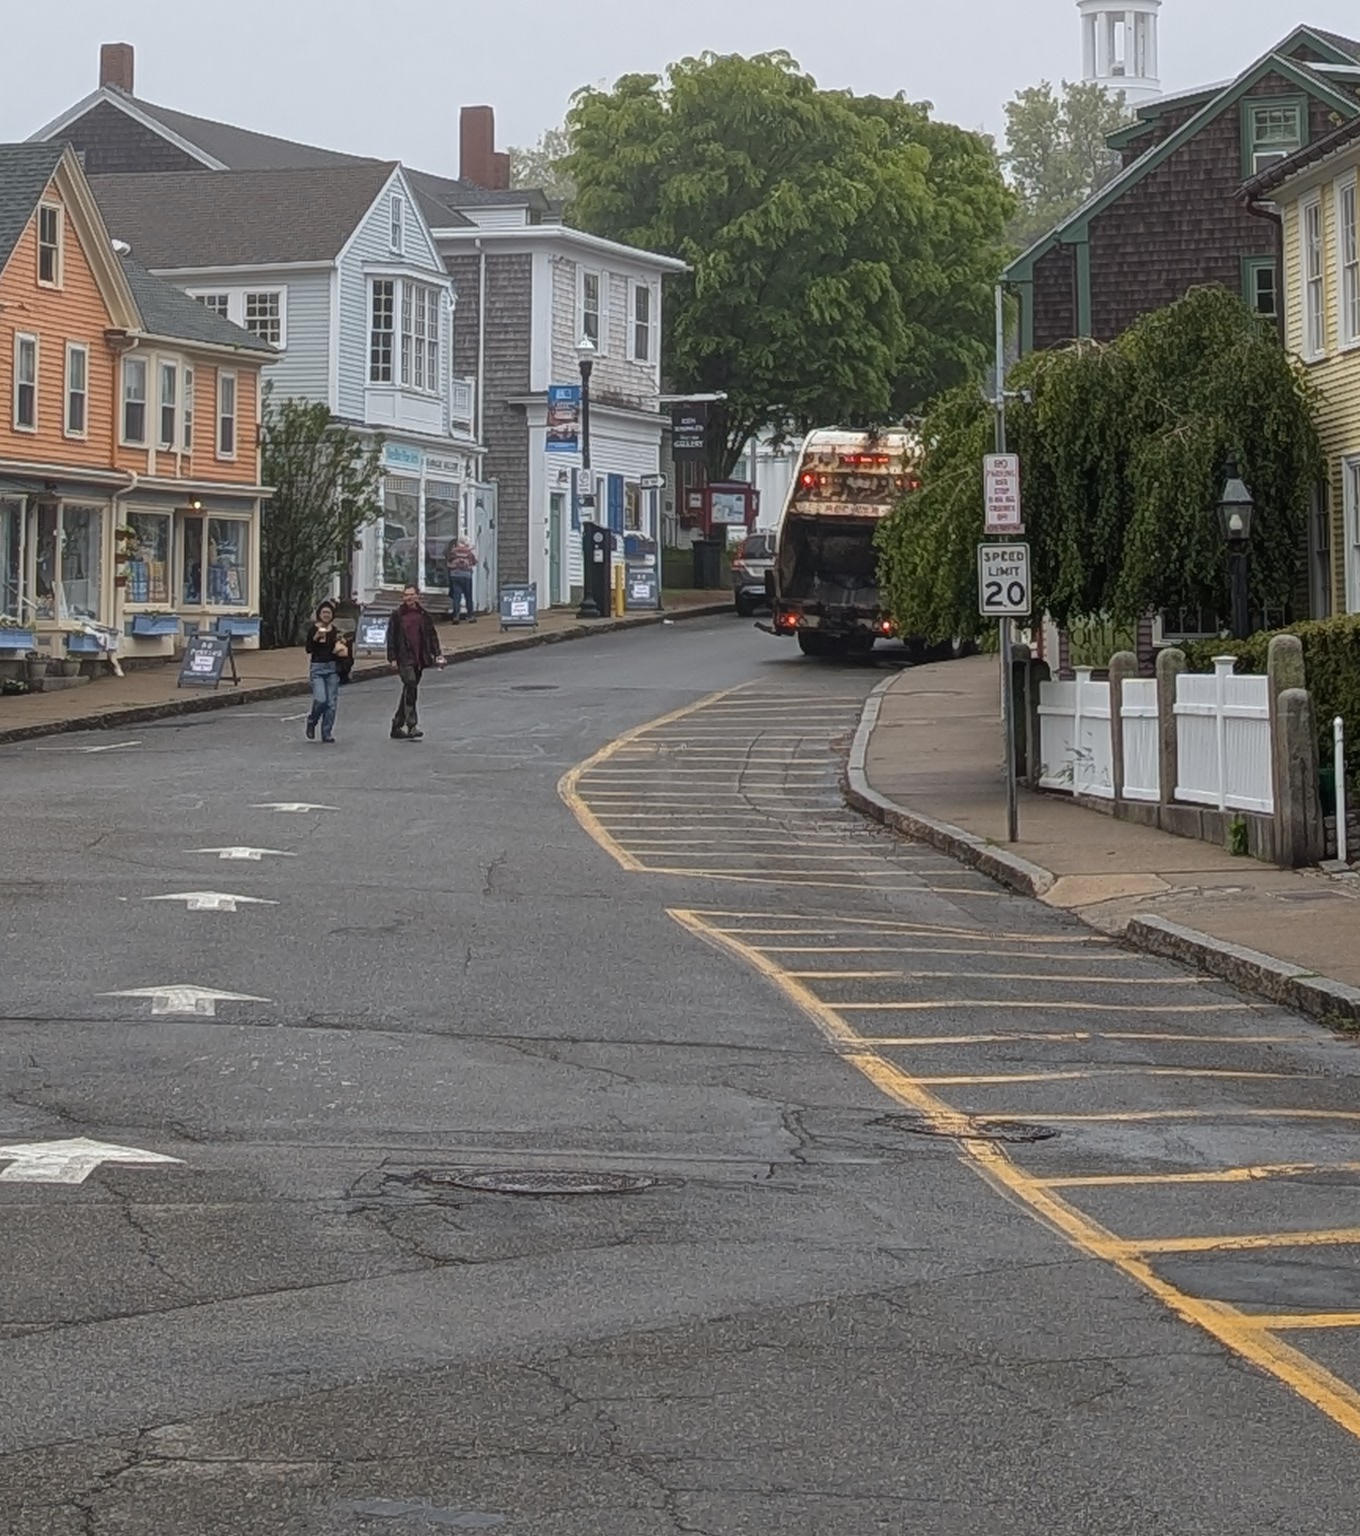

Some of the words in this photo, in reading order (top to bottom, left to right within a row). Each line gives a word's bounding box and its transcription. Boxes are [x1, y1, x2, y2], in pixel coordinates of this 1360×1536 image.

[983, 550, 1024, 563] SPEED
[988, 566, 1020, 577] LIMIT
[985, 580, 1026, 607] 20
